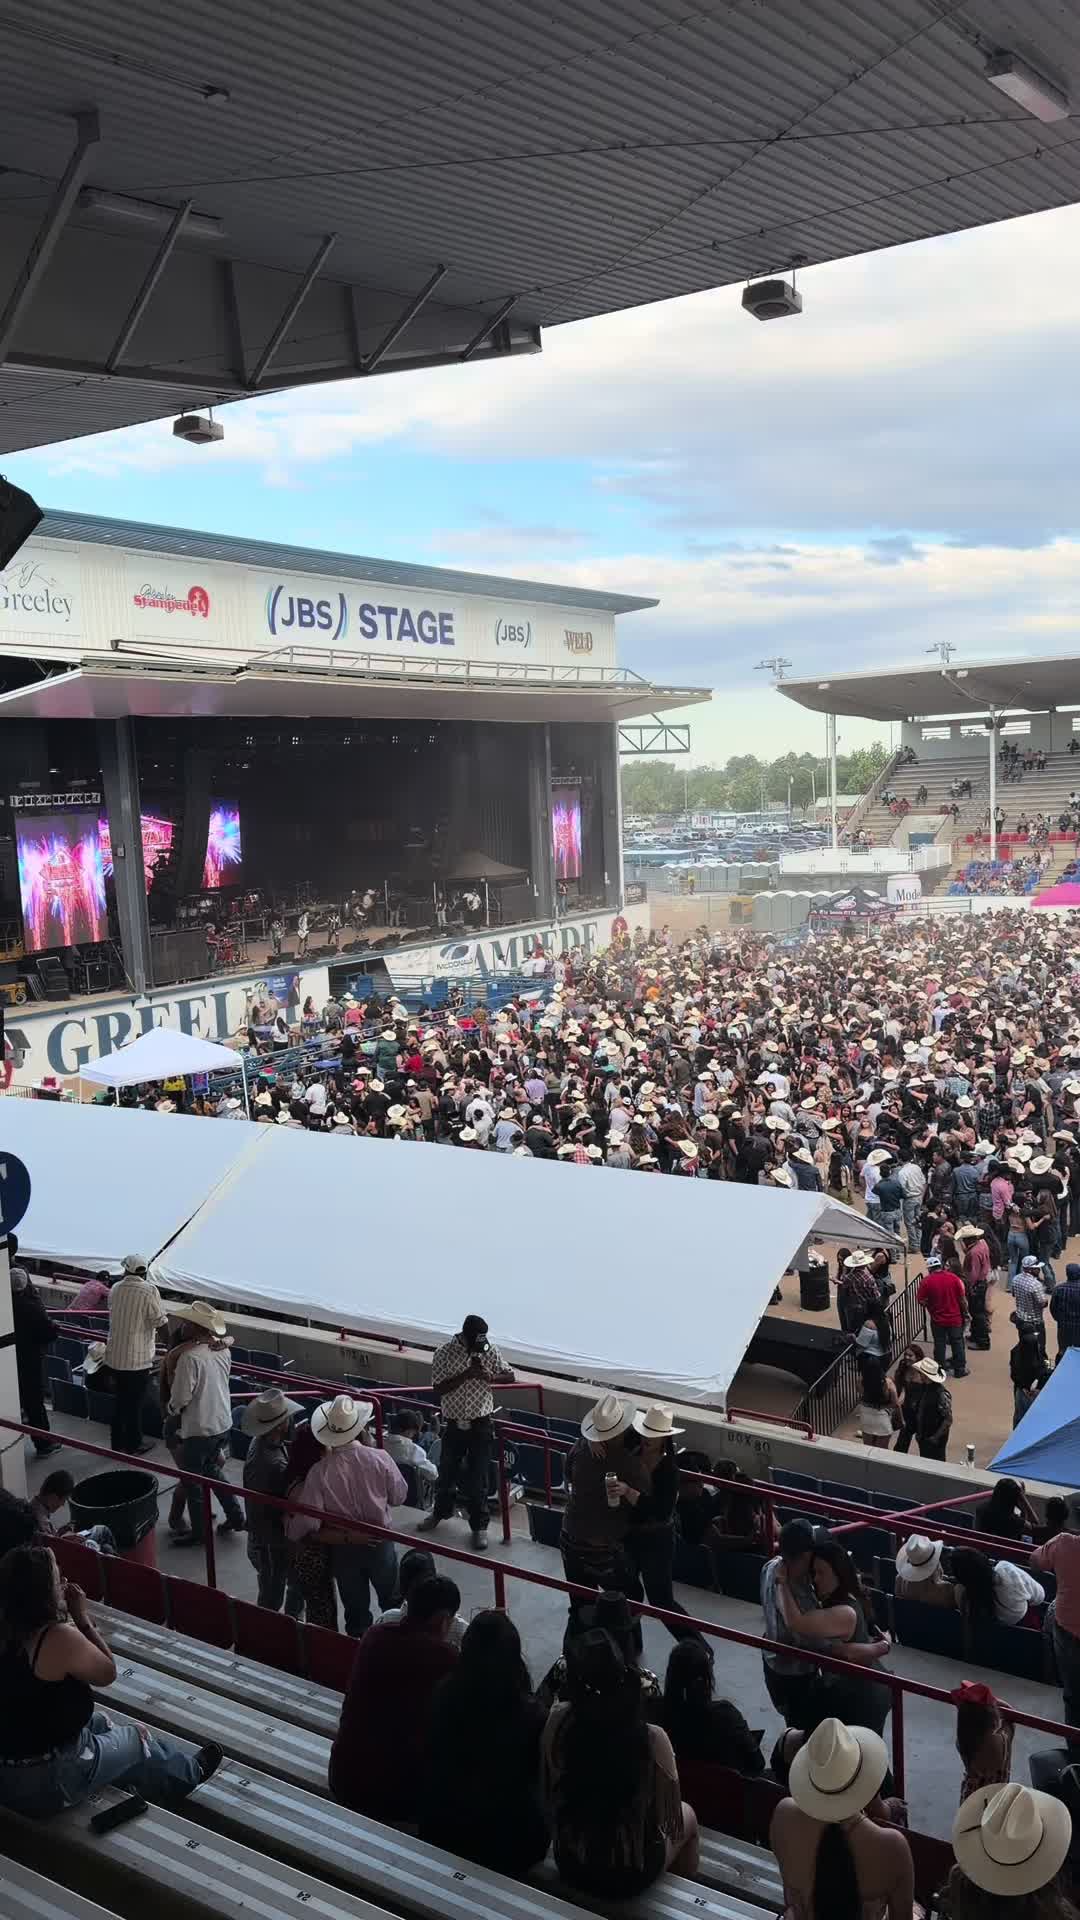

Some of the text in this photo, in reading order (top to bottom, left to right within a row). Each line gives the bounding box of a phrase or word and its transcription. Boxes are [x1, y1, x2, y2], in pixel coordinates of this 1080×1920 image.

[133, 594, 199, 613] Stampede
[358, 603, 455, 646] STAGE
[185, 1840, 200, 1849] 25
